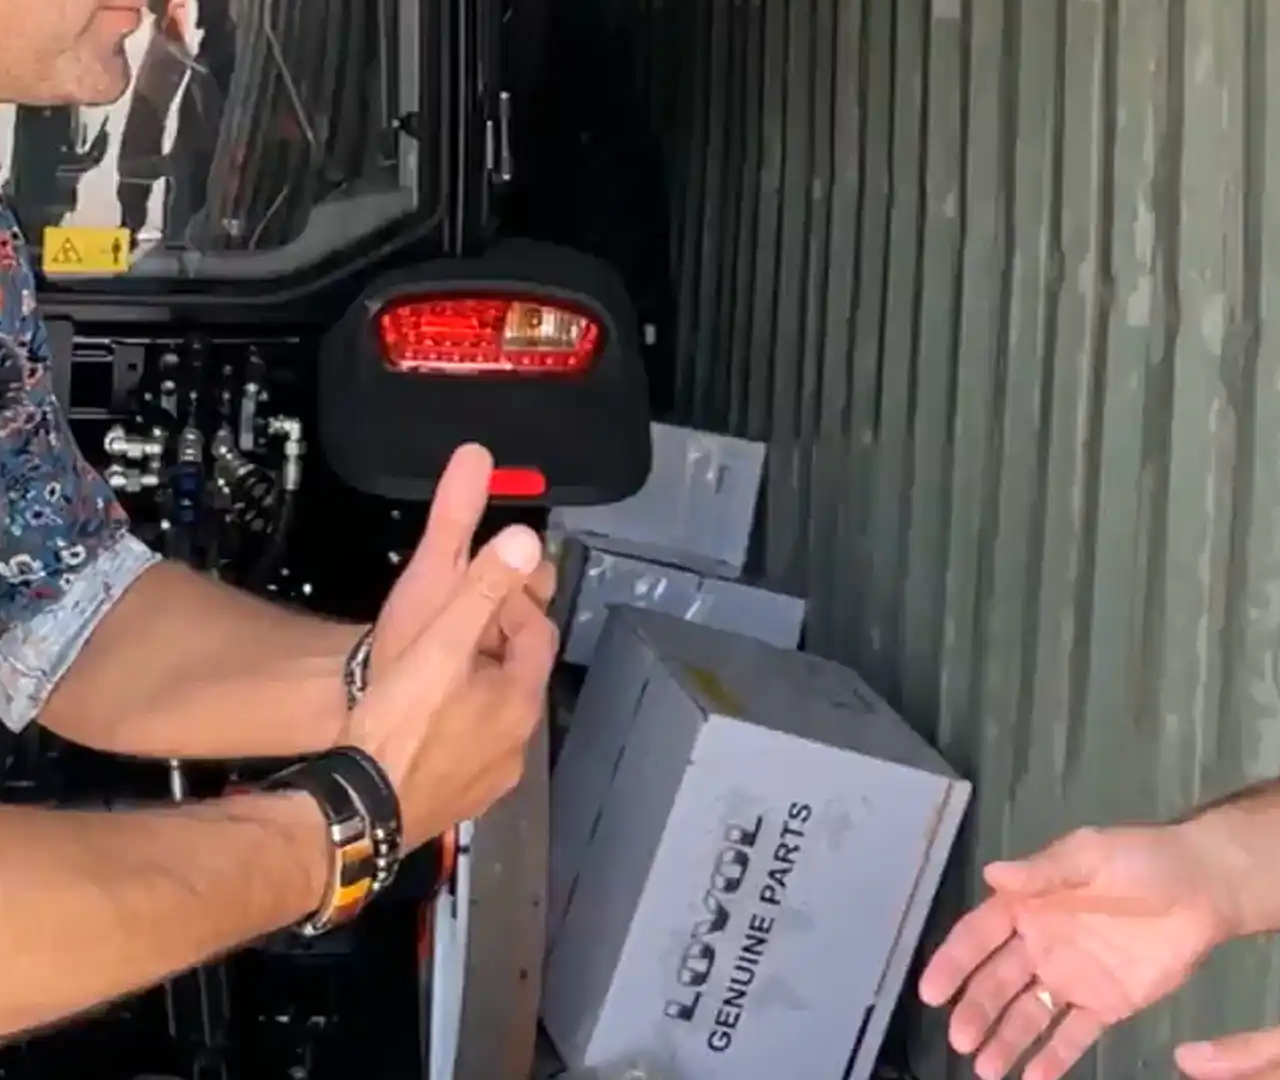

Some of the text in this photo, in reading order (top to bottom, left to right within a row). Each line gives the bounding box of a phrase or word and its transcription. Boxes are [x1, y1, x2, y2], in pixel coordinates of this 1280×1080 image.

[663, 814, 764, 1022] LOVOL
[706, 801, 813, 1054] GENUINE PARTS
